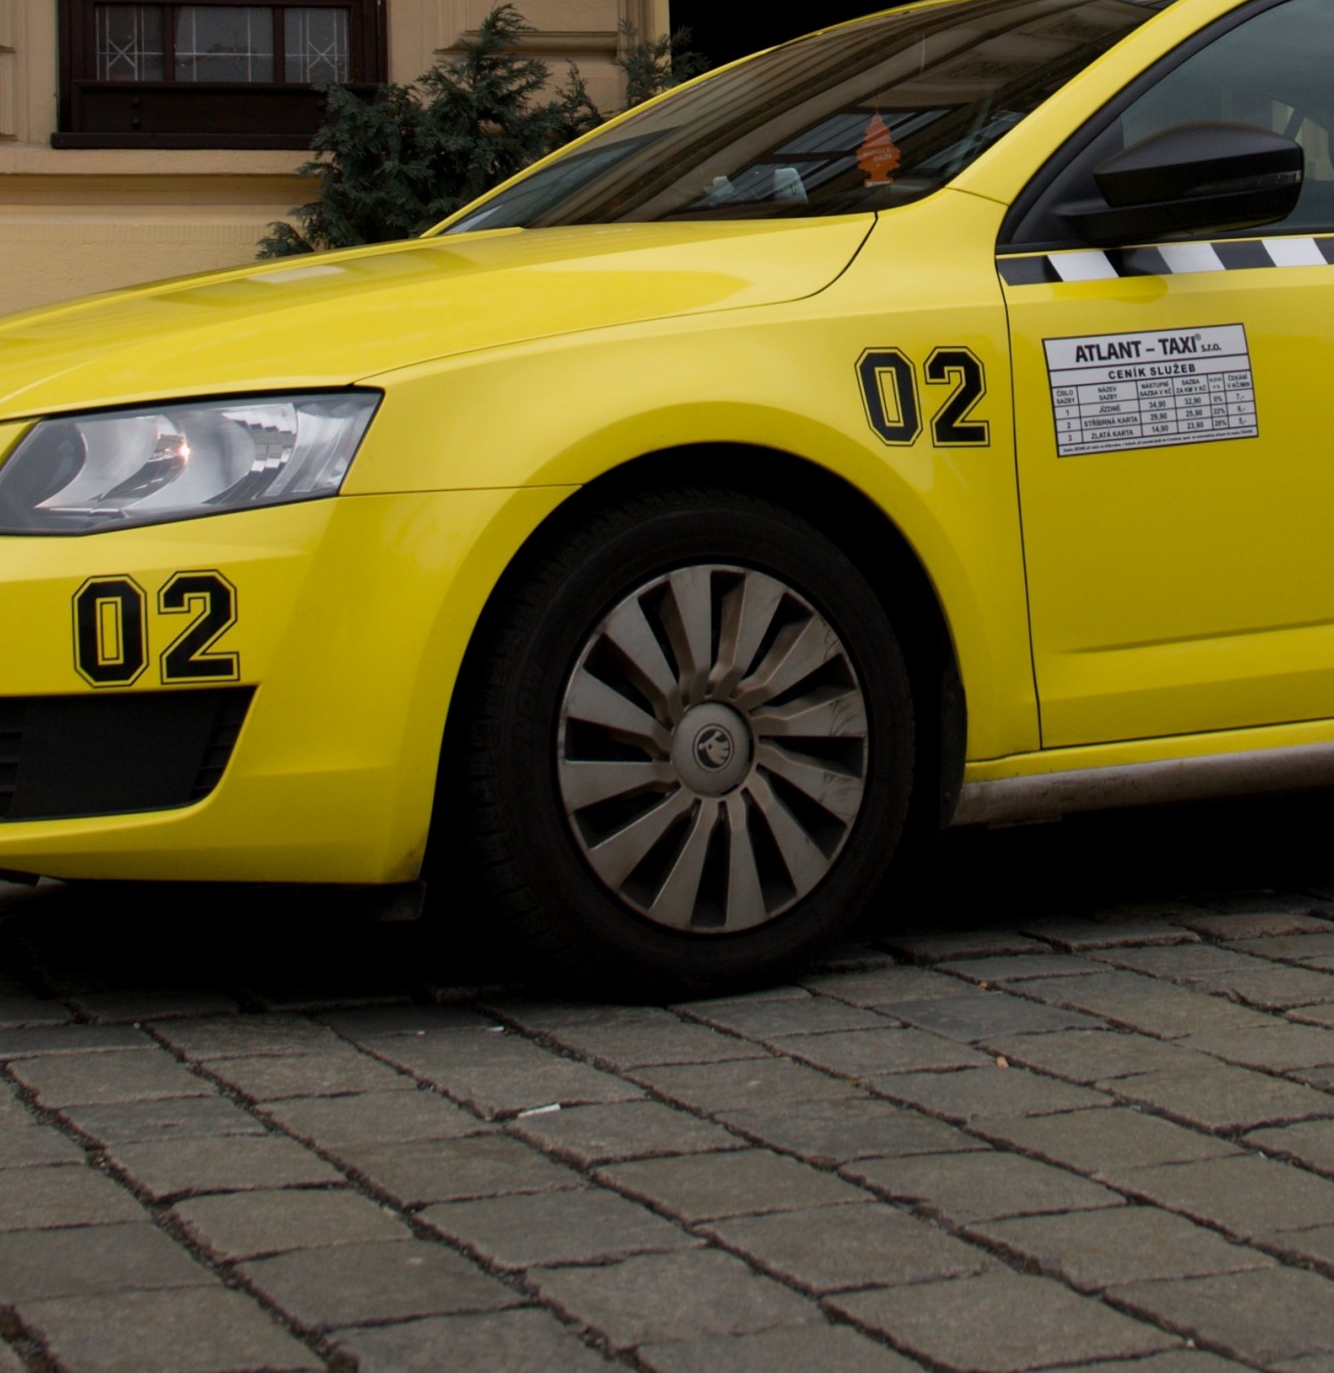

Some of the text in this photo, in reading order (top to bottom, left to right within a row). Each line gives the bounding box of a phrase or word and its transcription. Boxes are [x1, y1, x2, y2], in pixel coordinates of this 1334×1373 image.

[1076, 340, 1142, 362] ATLANT
[1108, 363, 1195, 379] CENÍK SLUŽEB
[854, 345, 990, 448] 02
[72, 568, 240, 688] 02
